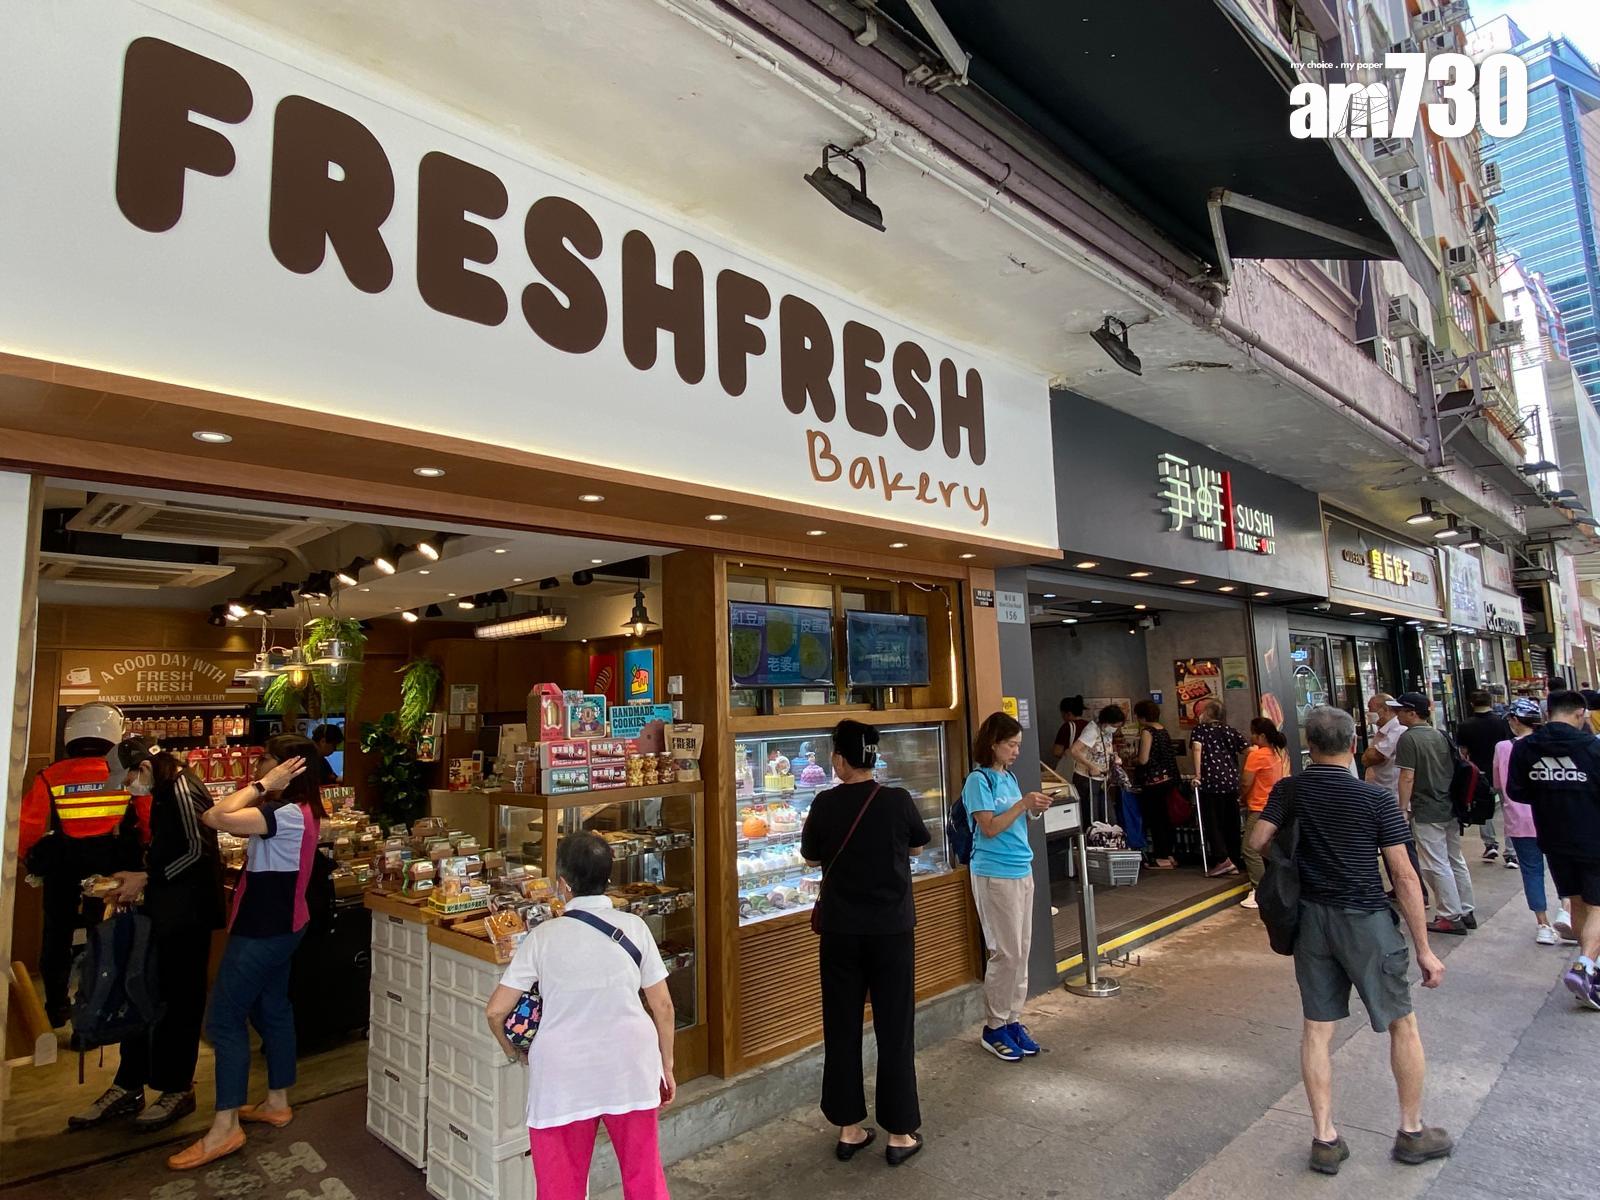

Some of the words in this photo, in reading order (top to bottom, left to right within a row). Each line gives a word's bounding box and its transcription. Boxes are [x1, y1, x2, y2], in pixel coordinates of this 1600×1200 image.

[806, 429, 989, 527] Bakery
[1158, 453, 1227, 542] 爭鮮
[1236, 504, 1275, 538] SUSHI
[1237, 532, 1276, 555] TAKE-OUT
[1005, 610, 1018, 621] 156
[100, 671, 114, 684] A
[113, 654, 156, 676] GOOD
[161, 653, 190, 668] DAY
[193, 658, 227, 684] WITH
[137, 670, 194, 682] FRESH
[136, 682, 193, 692] FRESH
[146, 694, 173, 702] HAPPY
[612, 706, 655, 718] HANDMADE
[613, 717, 647, 729] COOKIES
[1529, 768, 1588, 782] adidas
